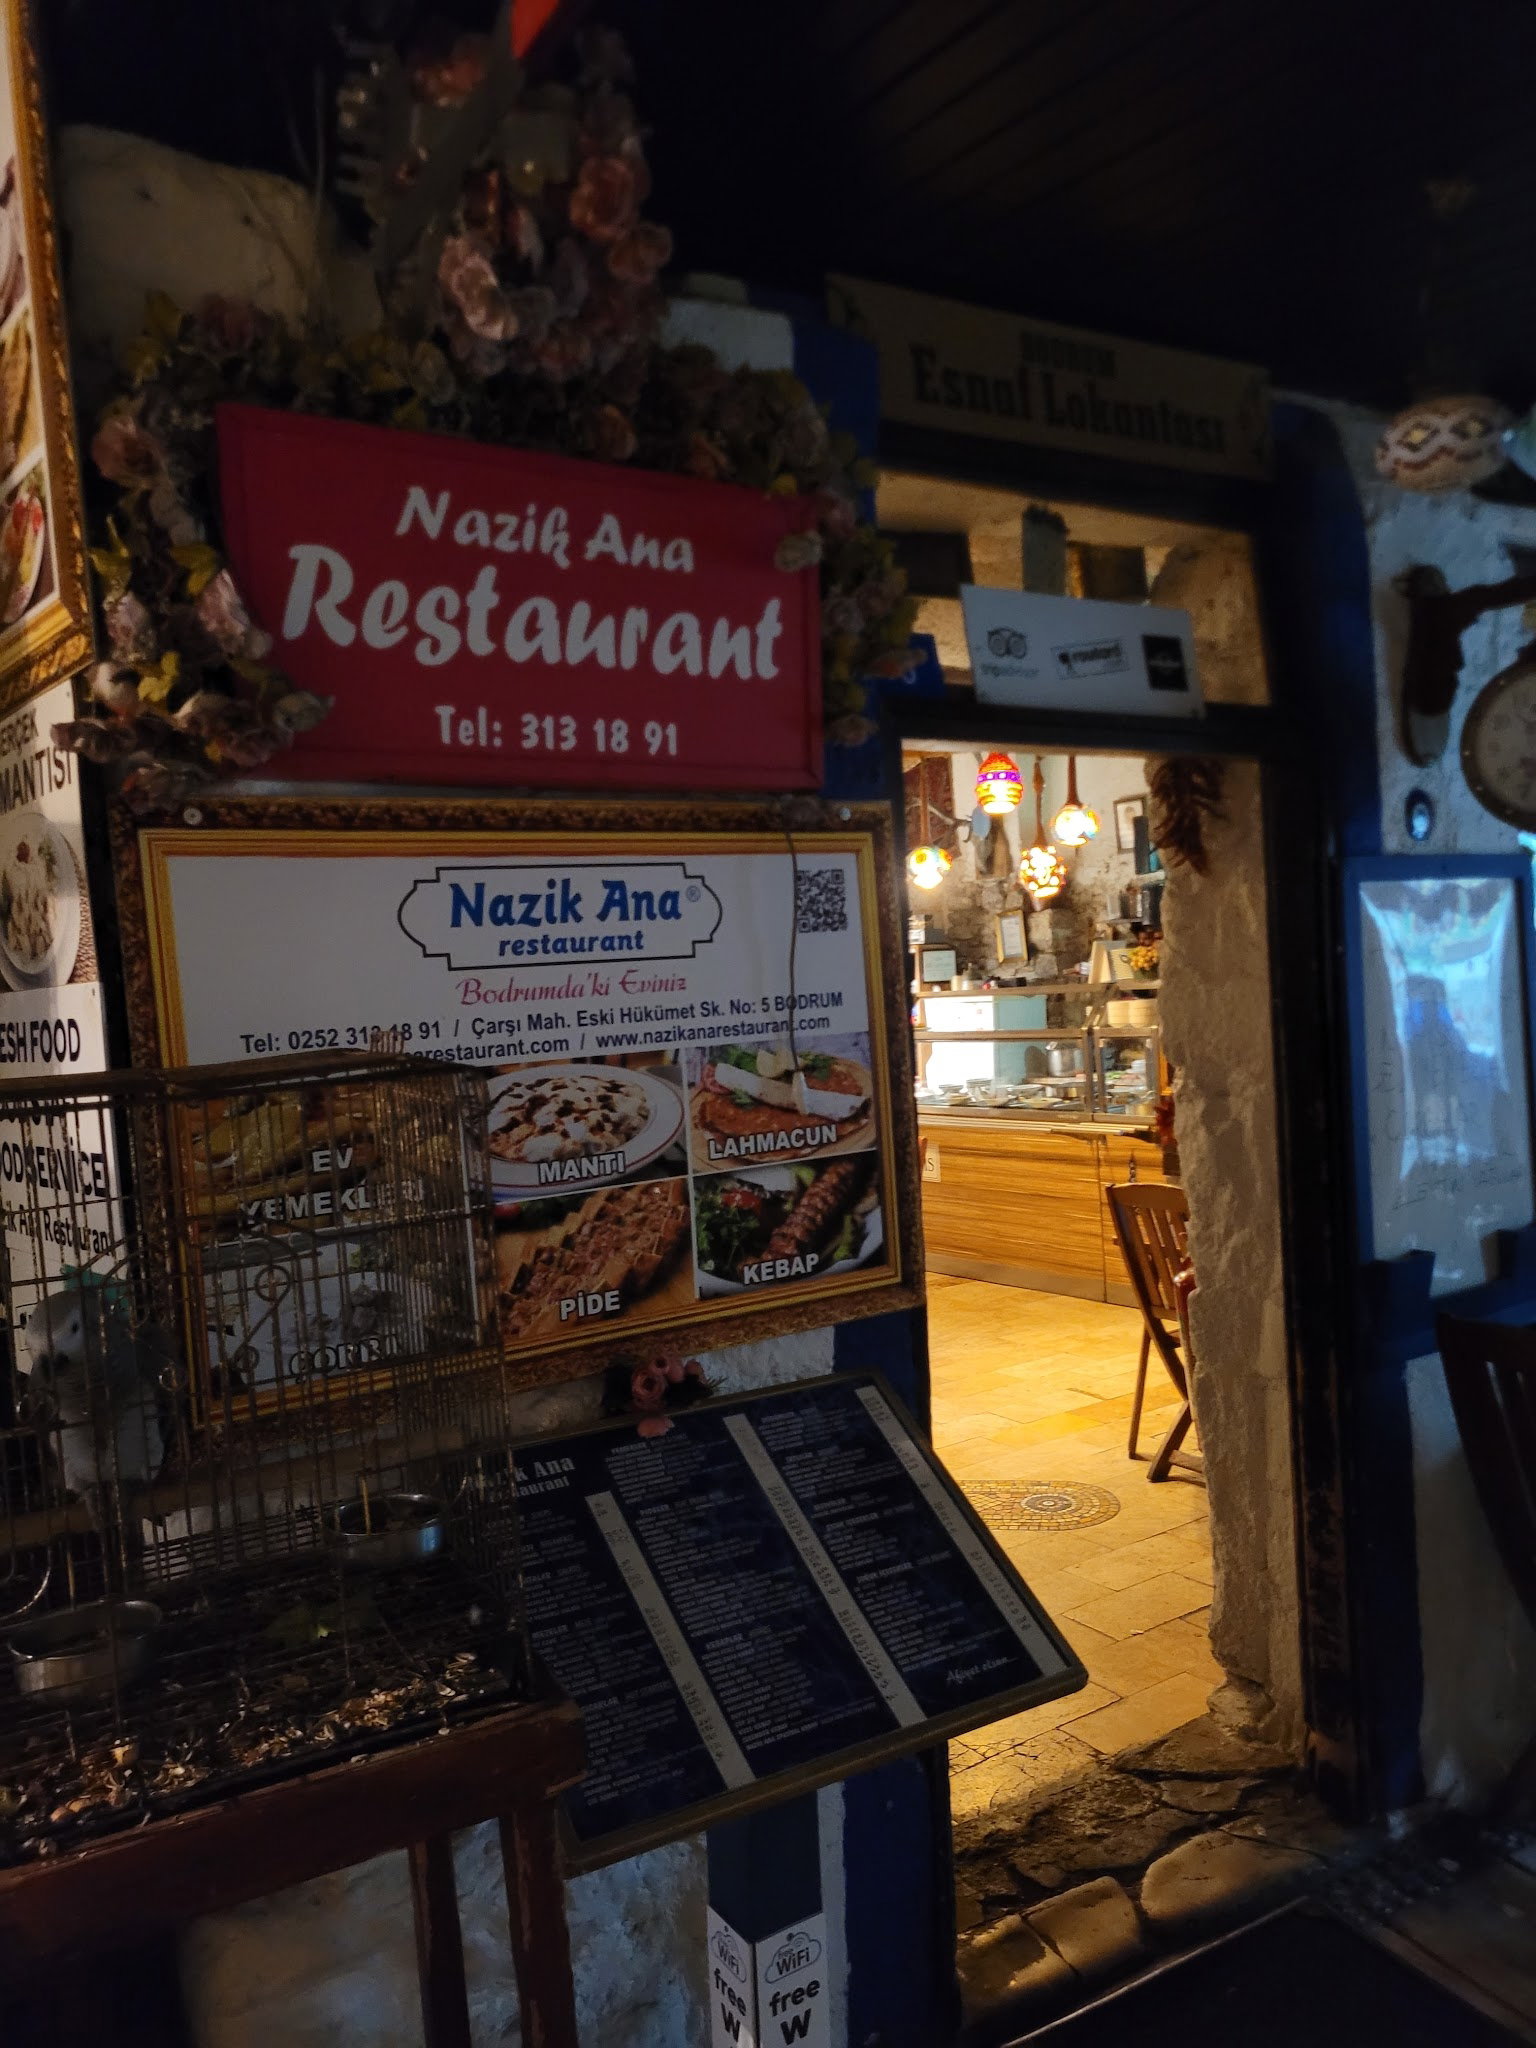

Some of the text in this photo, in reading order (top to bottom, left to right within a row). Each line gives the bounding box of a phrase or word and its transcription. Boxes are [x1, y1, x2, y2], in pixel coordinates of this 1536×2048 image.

[911, 343, 1031, 421] Esnaf
[396, 485, 696, 574] Nazik Ana
[282, 544, 783, 681] Restaurant
[434, 704, 679, 757] Tel: 313 18 91
[449, 878, 683, 929] Nazik Ana
[498, 930, 645, 957] restaurant
[456, 970, 688, 1006] Bodrumda'ki Eviniz
[30, 1018, 81, 1063] FOOD
[240, 1033, 280, 1054] Tel:
[288, 1027, 340, 1052] 0252
[389, 1023, 413, 1042] 18
[418, 1020, 441, 1041] 91
[471, 1017, 522, 1038] Çarşı
[527, 1012, 572, 1032] Mah.
[576, 1008, 615, 1028] Eski
[620, 1003, 696, 1025] Hükümet
[700, 1001, 725, 1019] Sk.
[729, 998, 757, 1016] No:
[761, 996, 771, 1013] 5
[774, 991, 843, 1012] BODRUM
[404, 1035, 570, 1063] arestaurant.com
[595, 1016, 830, 1049] www.nazikanarestauran.com
[311, 1147, 354, 1173] EV
[708, 1124, 838, 1160] LAHMACUN
[537, 1152, 626, 1186] MANTI
[742, 1251, 821, 1286] KEBAP
[559, 1287, 622, 1322] PİDE
[534, 1456, 577, 1479] Ana
[516, 1475, 571, 1498] aurant
[717, 1941, 740, 1976] WiFi
[776, 1947, 810, 1975] WiFi
[714, 1967, 747, 2017] free
[769, 1980, 821, 2017] free
[720, 2002, 741, 2043] W
[780, 2008, 812, 2045] W
